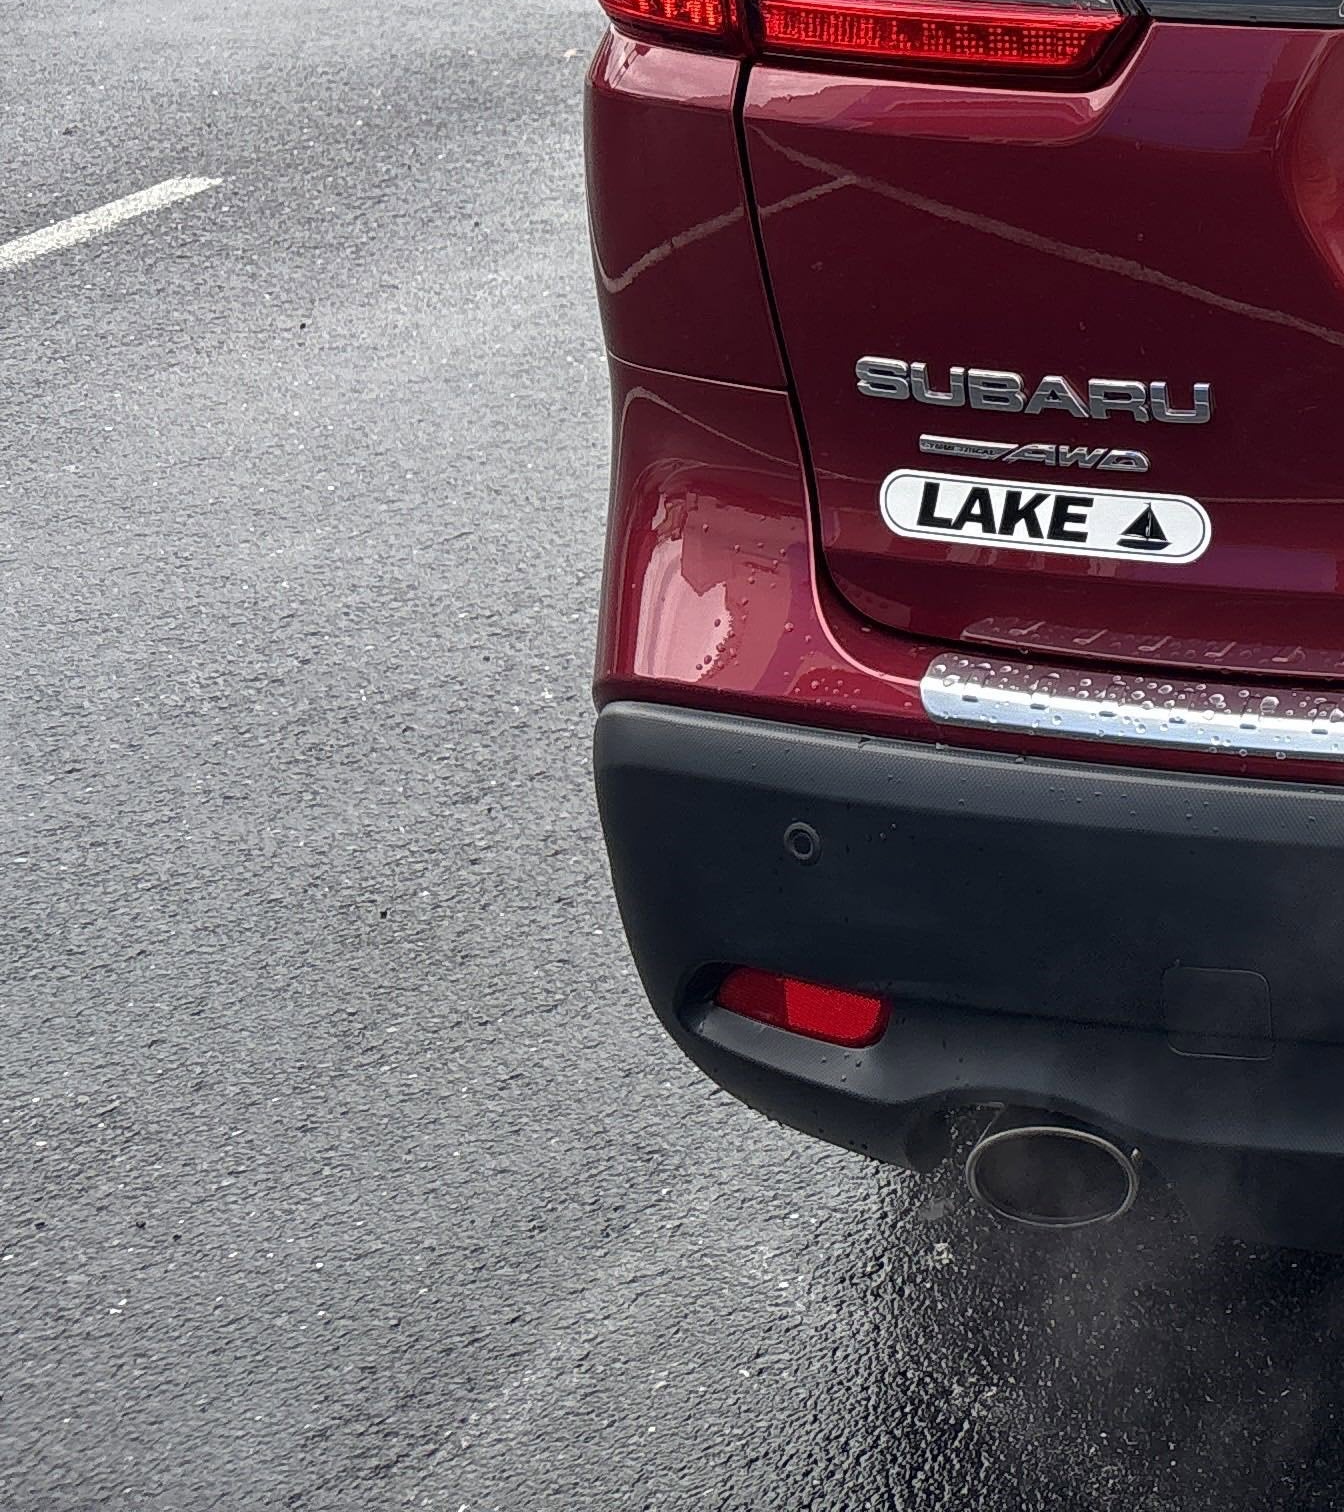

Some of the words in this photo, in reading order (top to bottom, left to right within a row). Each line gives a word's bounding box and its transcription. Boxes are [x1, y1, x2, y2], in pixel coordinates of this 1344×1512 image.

[855, 355, 1213, 424] SUBARU
[1002, 443, 1150, 473] AWD
[916, 481, 1094, 543] LAKE
